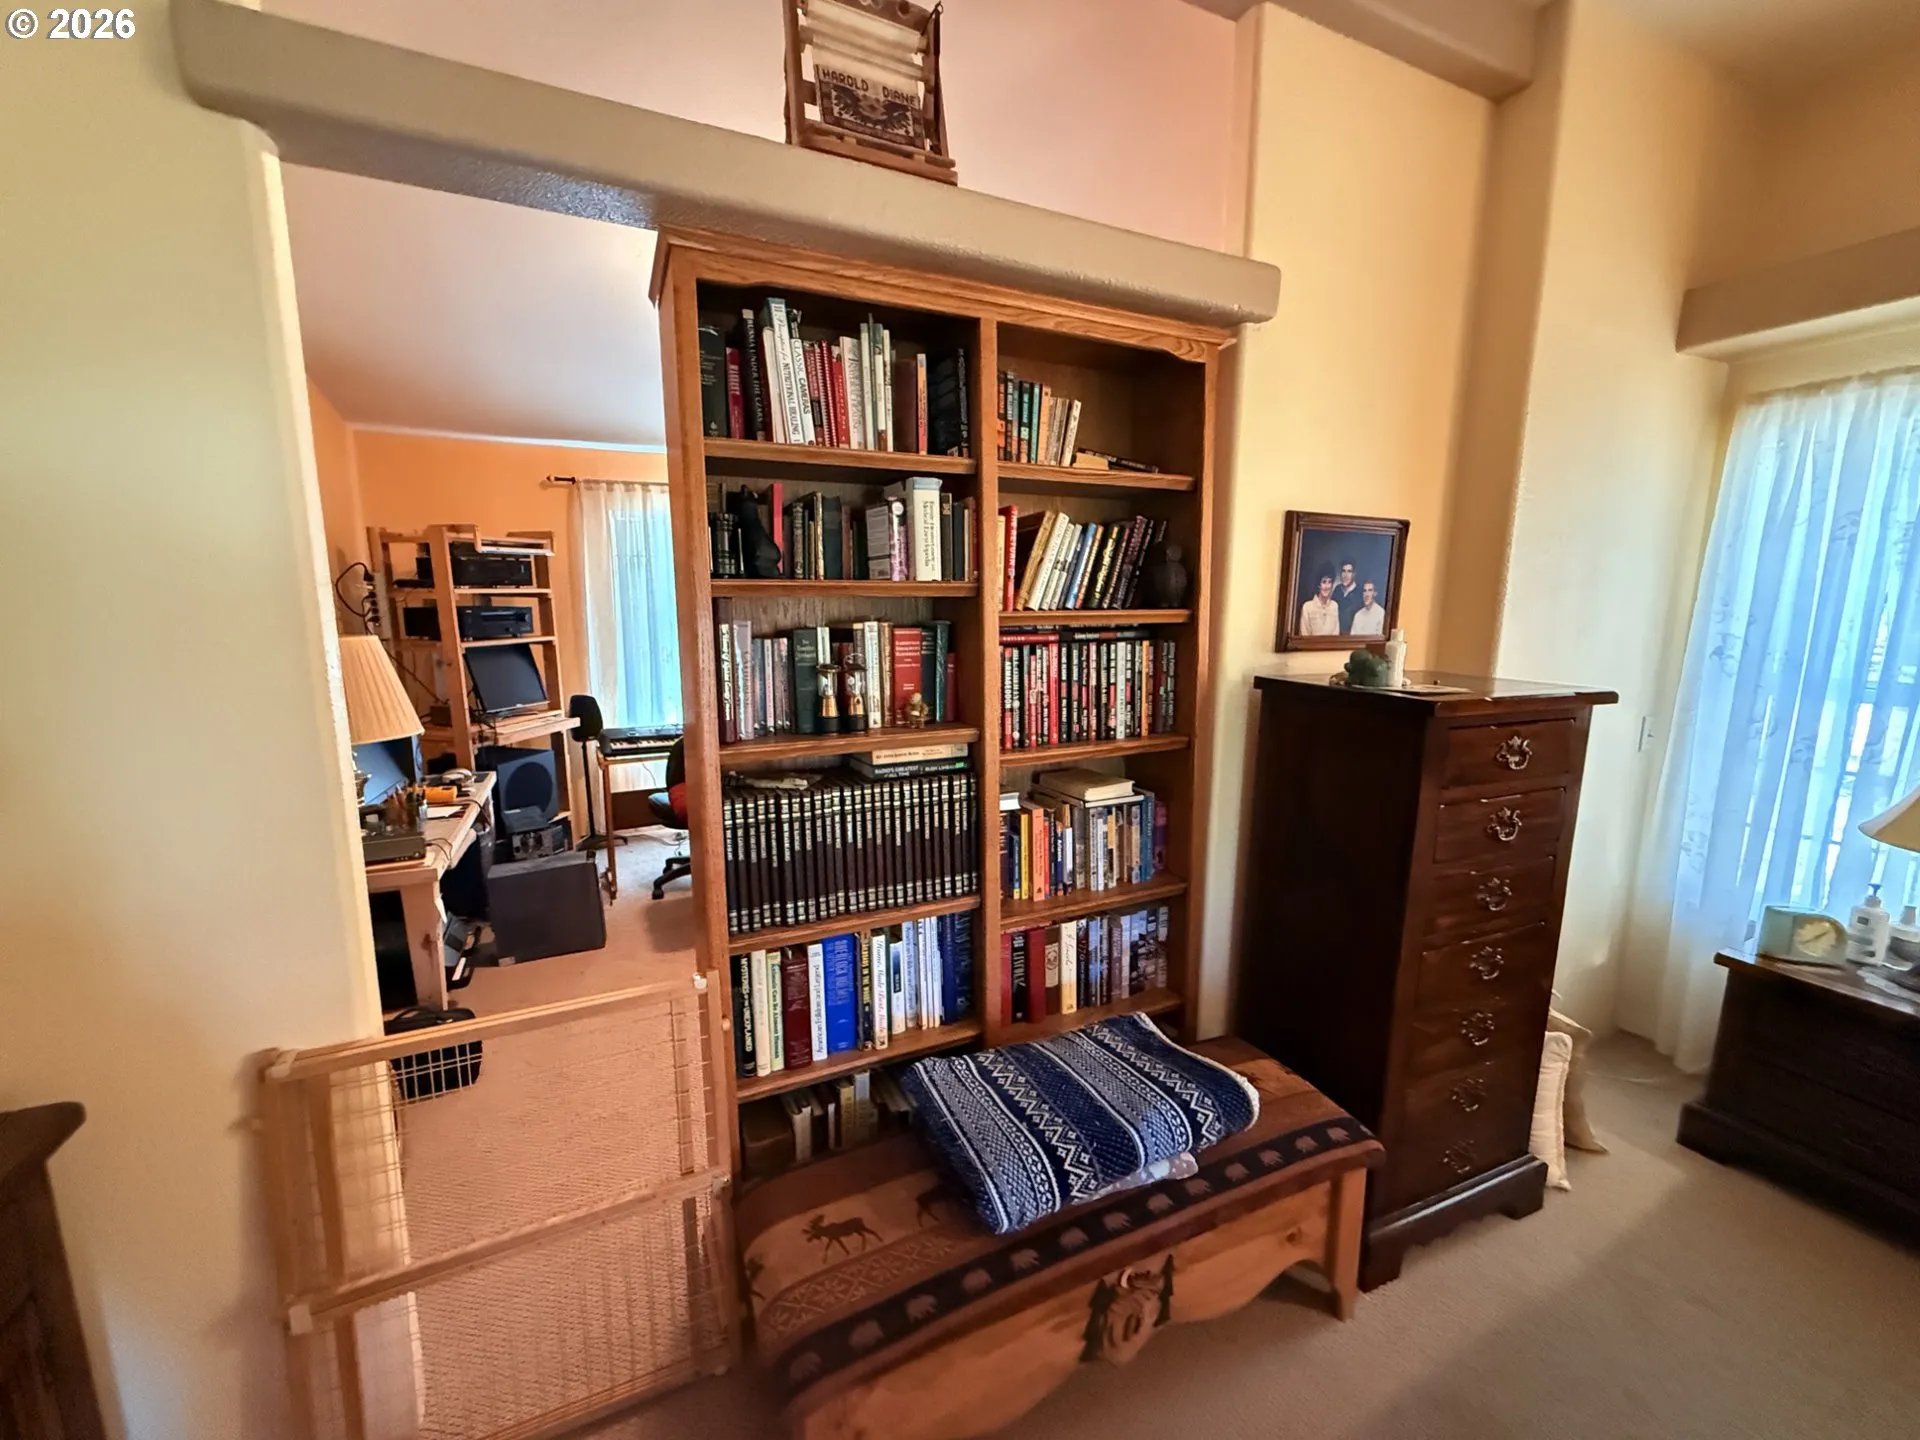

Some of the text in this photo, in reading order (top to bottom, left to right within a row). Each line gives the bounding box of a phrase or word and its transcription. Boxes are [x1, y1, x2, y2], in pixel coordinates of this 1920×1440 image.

[822, 70, 869, 92] HAROLD
[882, 86, 917, 105] DIANE
[747, 319, 755, 347] RUSSIA
[749, 350, 759, 378] UNDER
[793, 340, 811, 415] CLASSIC CAMERAS
[782, 362, 796, 406] NUTRITIONAL
[754, 397, 764, 422] CZARS
[788, 406, 800, 435] HEALING
[1004, 661, 1012, 709] ARMAGEDDON
[895, 765, 919, 773] GREATEST
[740, 958, 750, 994] MYSTERIES
[744, 1007, 753, 1052] UNEXPLAINED
[815, 1024, 823, 1053] American
